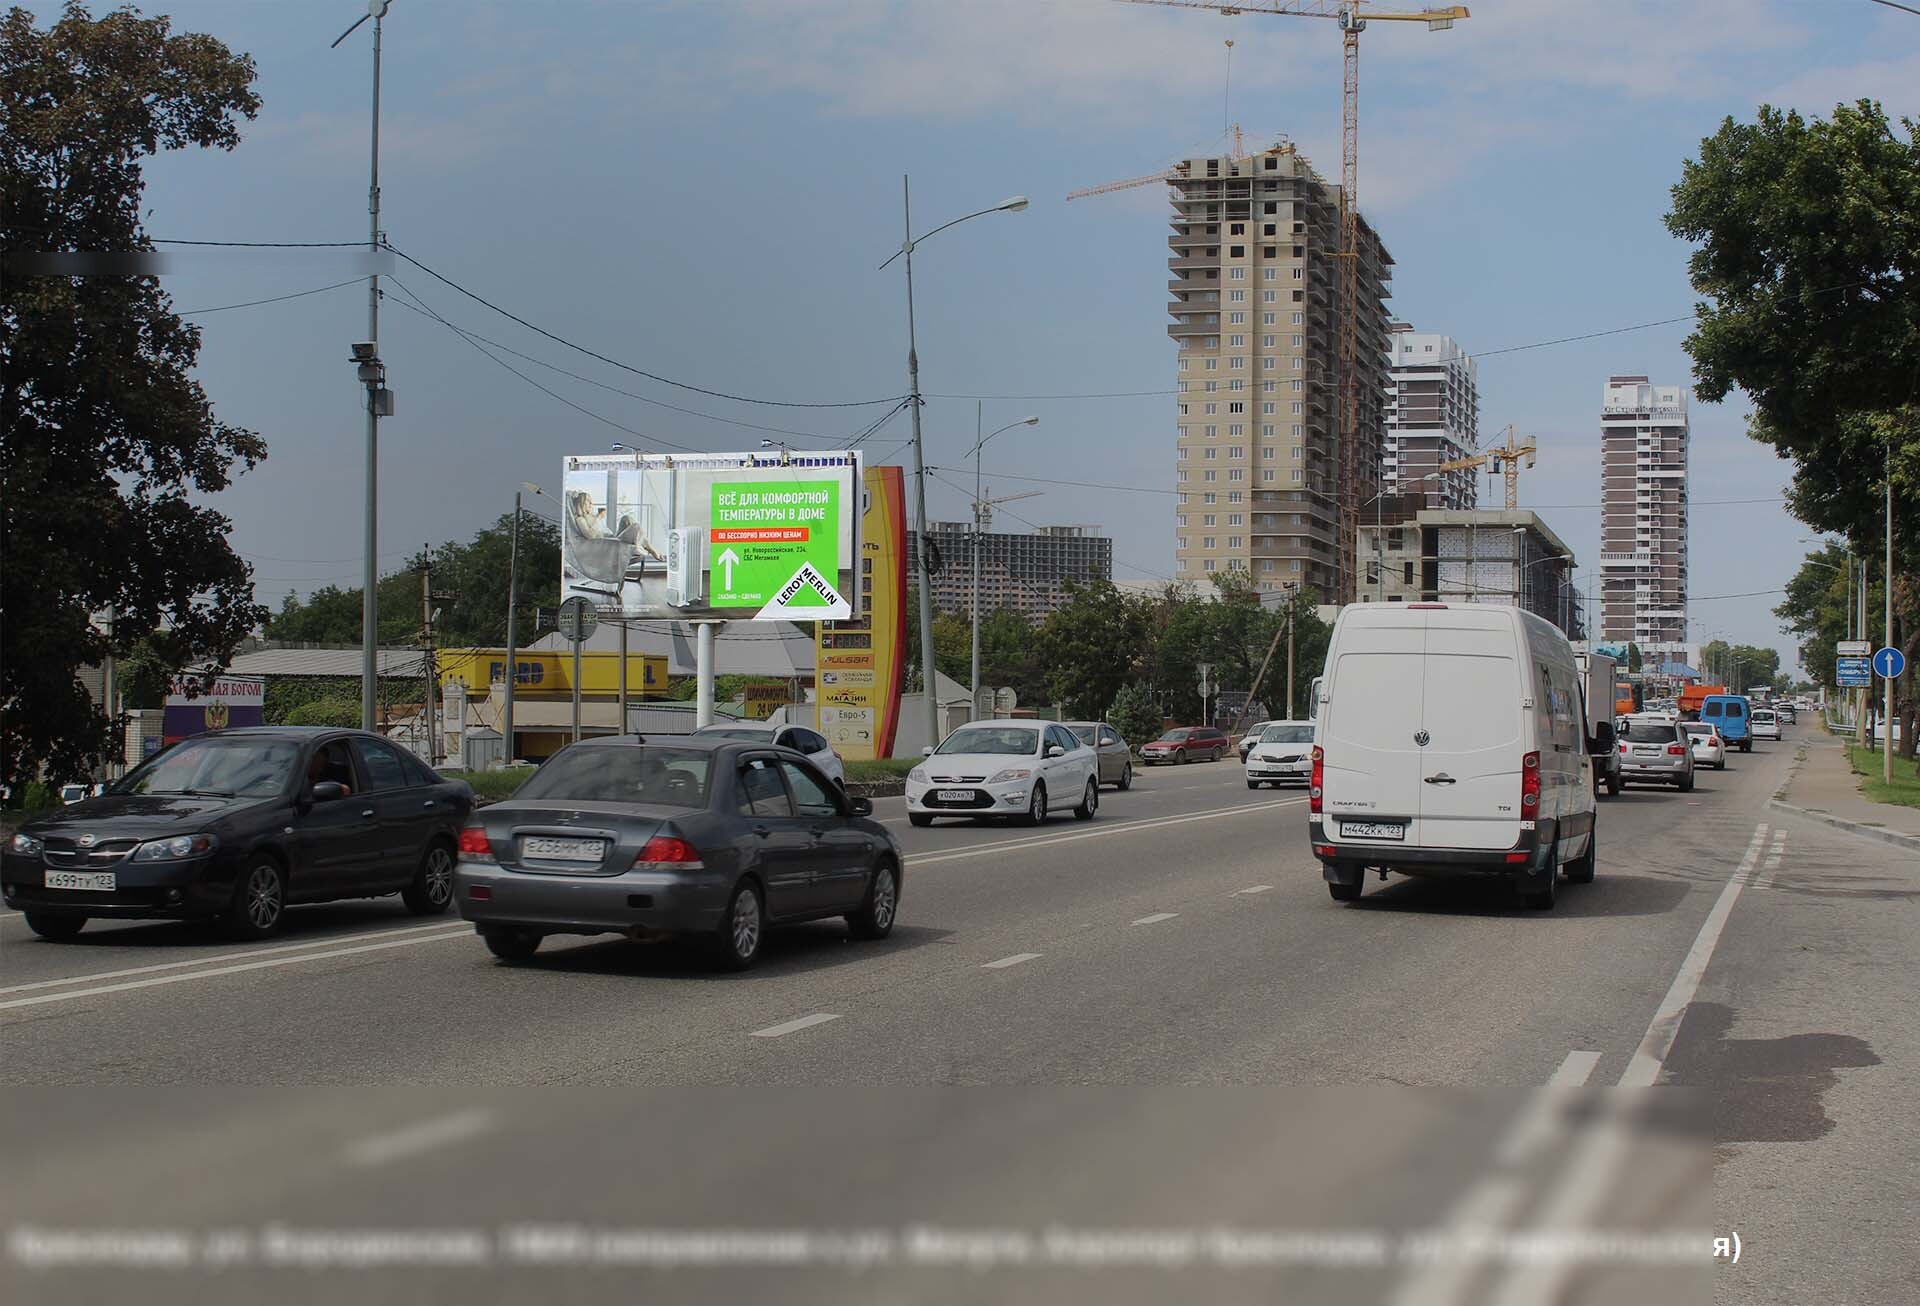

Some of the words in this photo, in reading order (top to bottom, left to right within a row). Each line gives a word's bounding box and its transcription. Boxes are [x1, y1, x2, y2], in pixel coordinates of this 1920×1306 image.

[718, 491, 737, 506] ВСЁ
[739, 493, 759, 506] ДЛЯ
[762, 490, 829, 505] КОМФОРТНОЙ
[719, 508, 786, 521] ТЕМПЕРАТУРЫ
[789, 508, 795, 520] В
[798, 507, 825, 521] ДОМЕ
[776, 574, 805, 606] LEROY
[801, 567, 838, 606] MERLIN
[231, 683, 261, 697] БОГОМ
[839, 710, 866, 719] Евро-5
